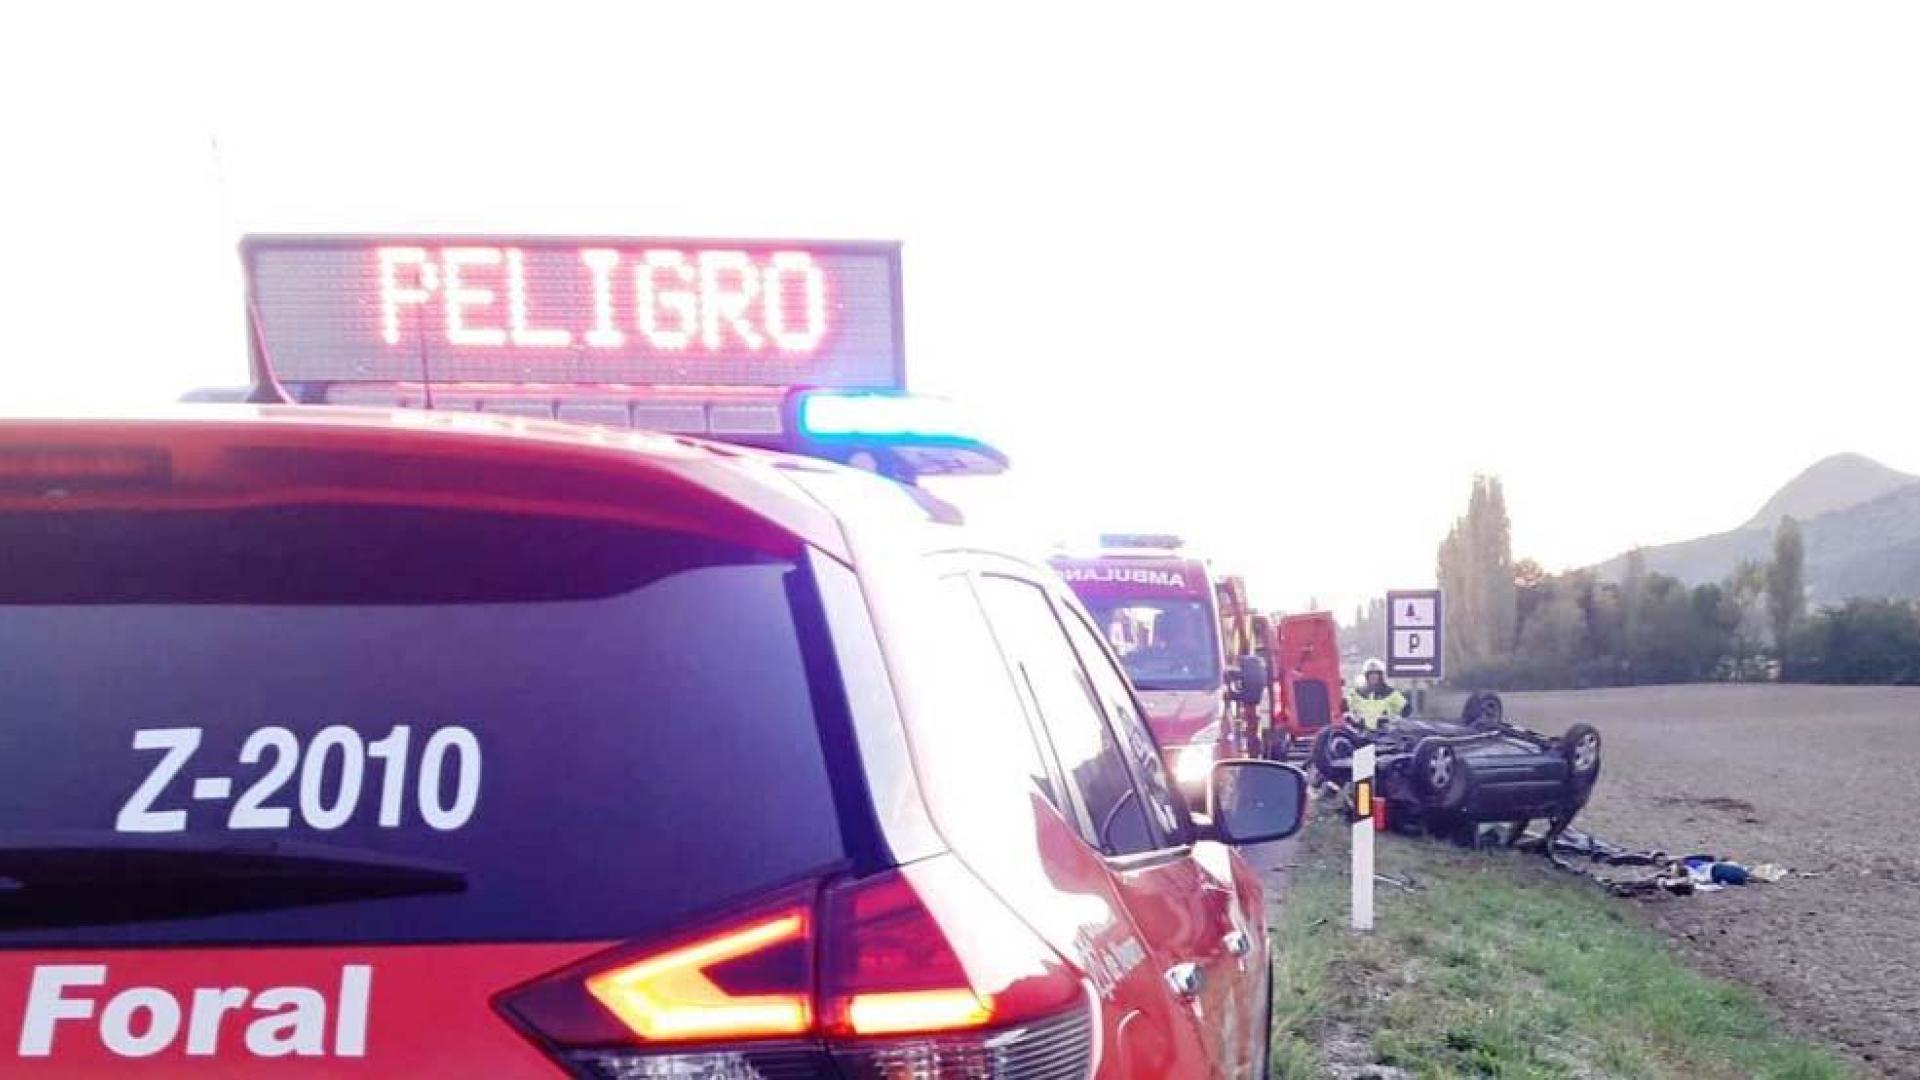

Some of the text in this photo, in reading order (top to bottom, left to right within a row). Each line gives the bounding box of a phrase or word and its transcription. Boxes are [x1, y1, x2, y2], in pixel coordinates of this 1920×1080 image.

[378, 246, 828, 351] PELIGRO
[1408, 633, 1420, 653] P
[117, 724, 481, 832] Z-2010
[18, 964, 373, 1057] Foral
